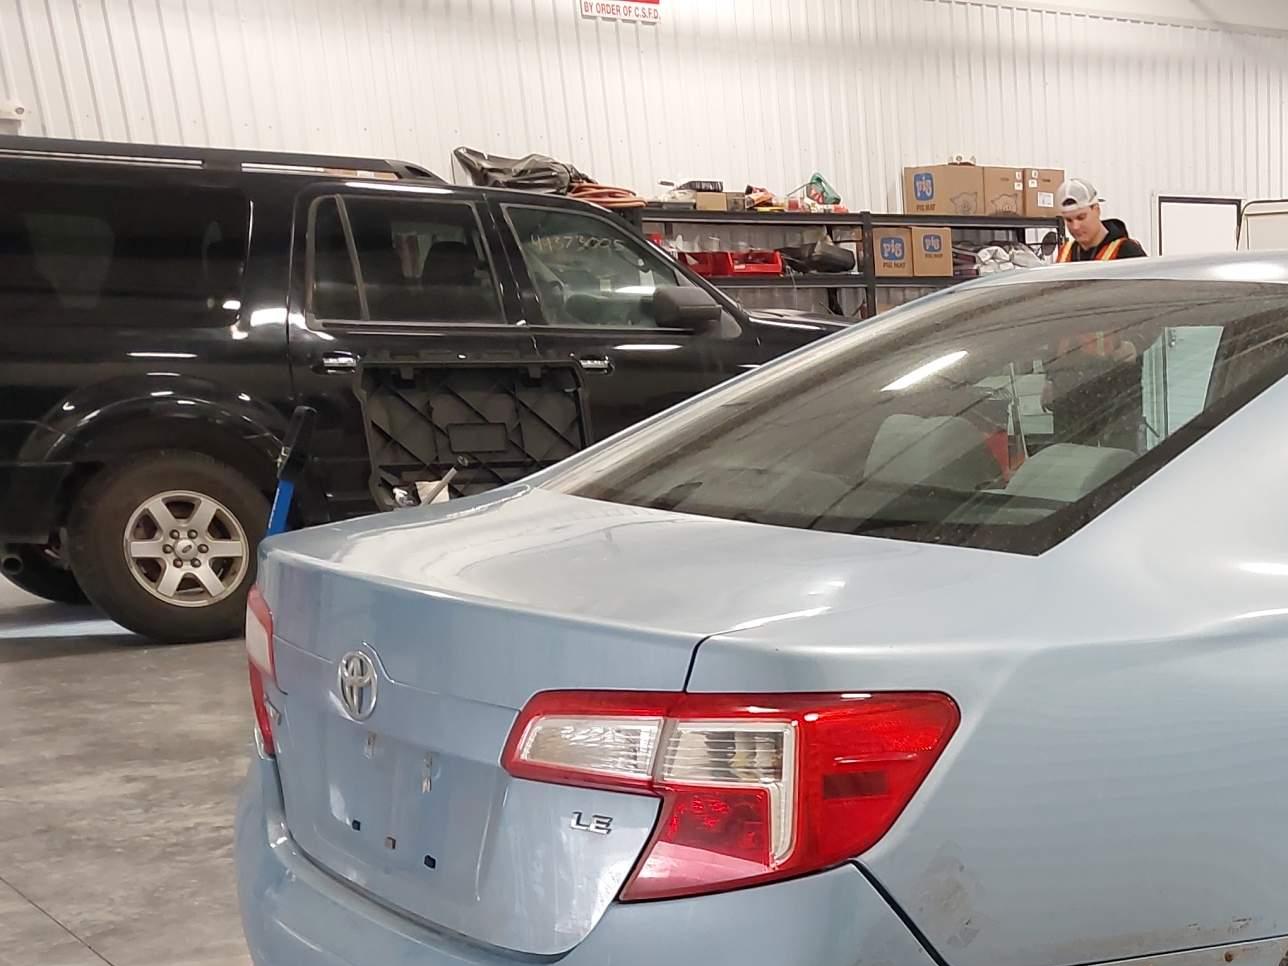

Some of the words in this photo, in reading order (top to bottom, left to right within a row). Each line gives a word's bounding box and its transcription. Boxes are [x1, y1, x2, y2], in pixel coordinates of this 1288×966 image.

[583, 1, 593, 13] BY
[596, 3, 620, 16] ORDER
[623, 5, 632, 17] OF
[916, 176, 932, 198] pig
[883, 239, 903, 258] pig
[925, 236, 940, 250] pig
[571, 811, 613, 835] LE
